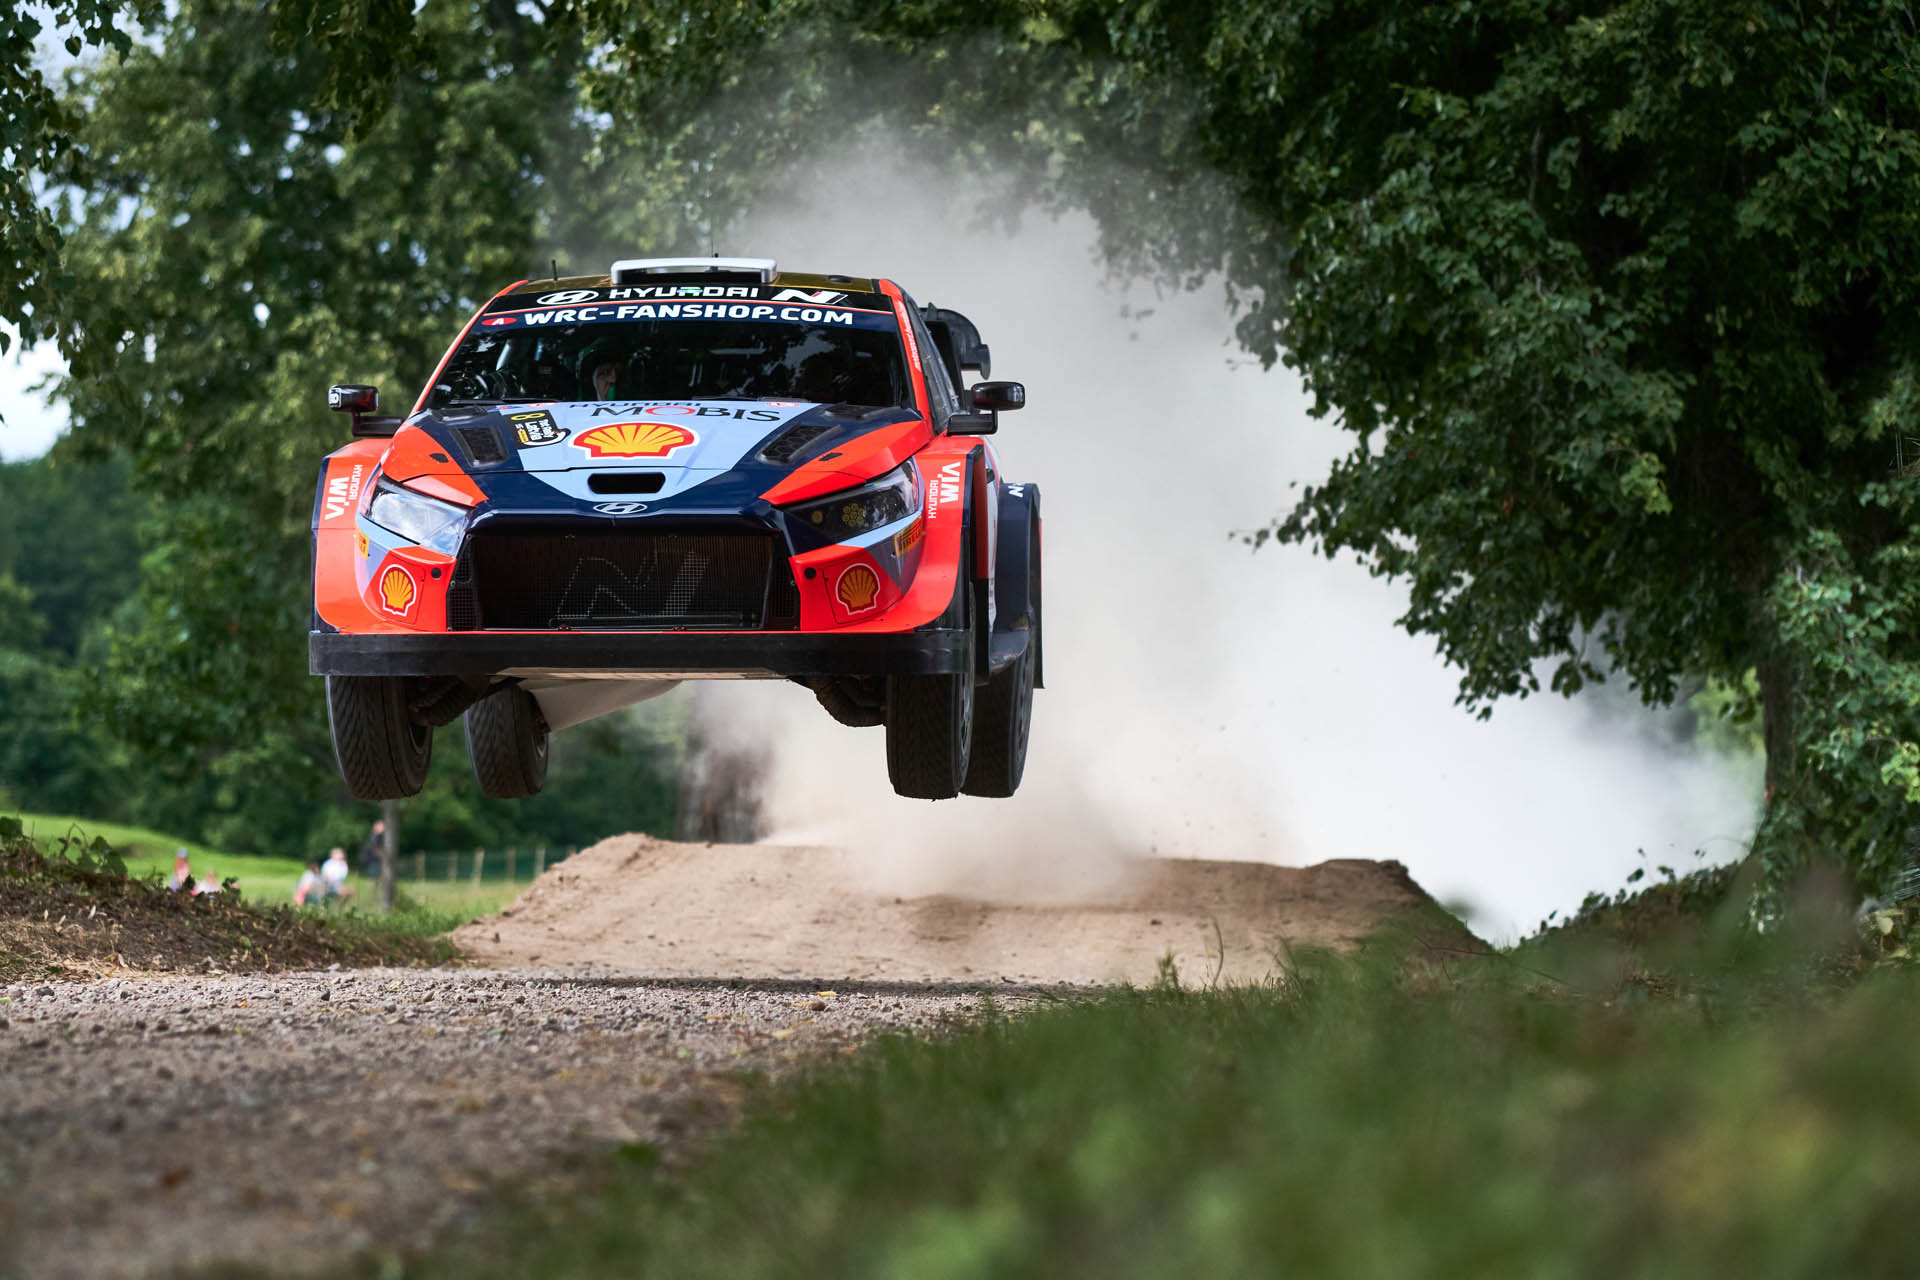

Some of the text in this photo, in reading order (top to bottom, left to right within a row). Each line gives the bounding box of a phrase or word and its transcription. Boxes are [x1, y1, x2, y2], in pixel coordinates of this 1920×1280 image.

[608, 285, 760, 299] HYUNDAI
[524, 304, 854, 326] WRC-FANSHOP.COM
[569, 401, 702, 409] HYUNDAI
[591, 406, 781, 422] MOBIS
[348, 464, 363, 500] HYUNDAI
[927, 480, 939, 519] HYUNDAI
